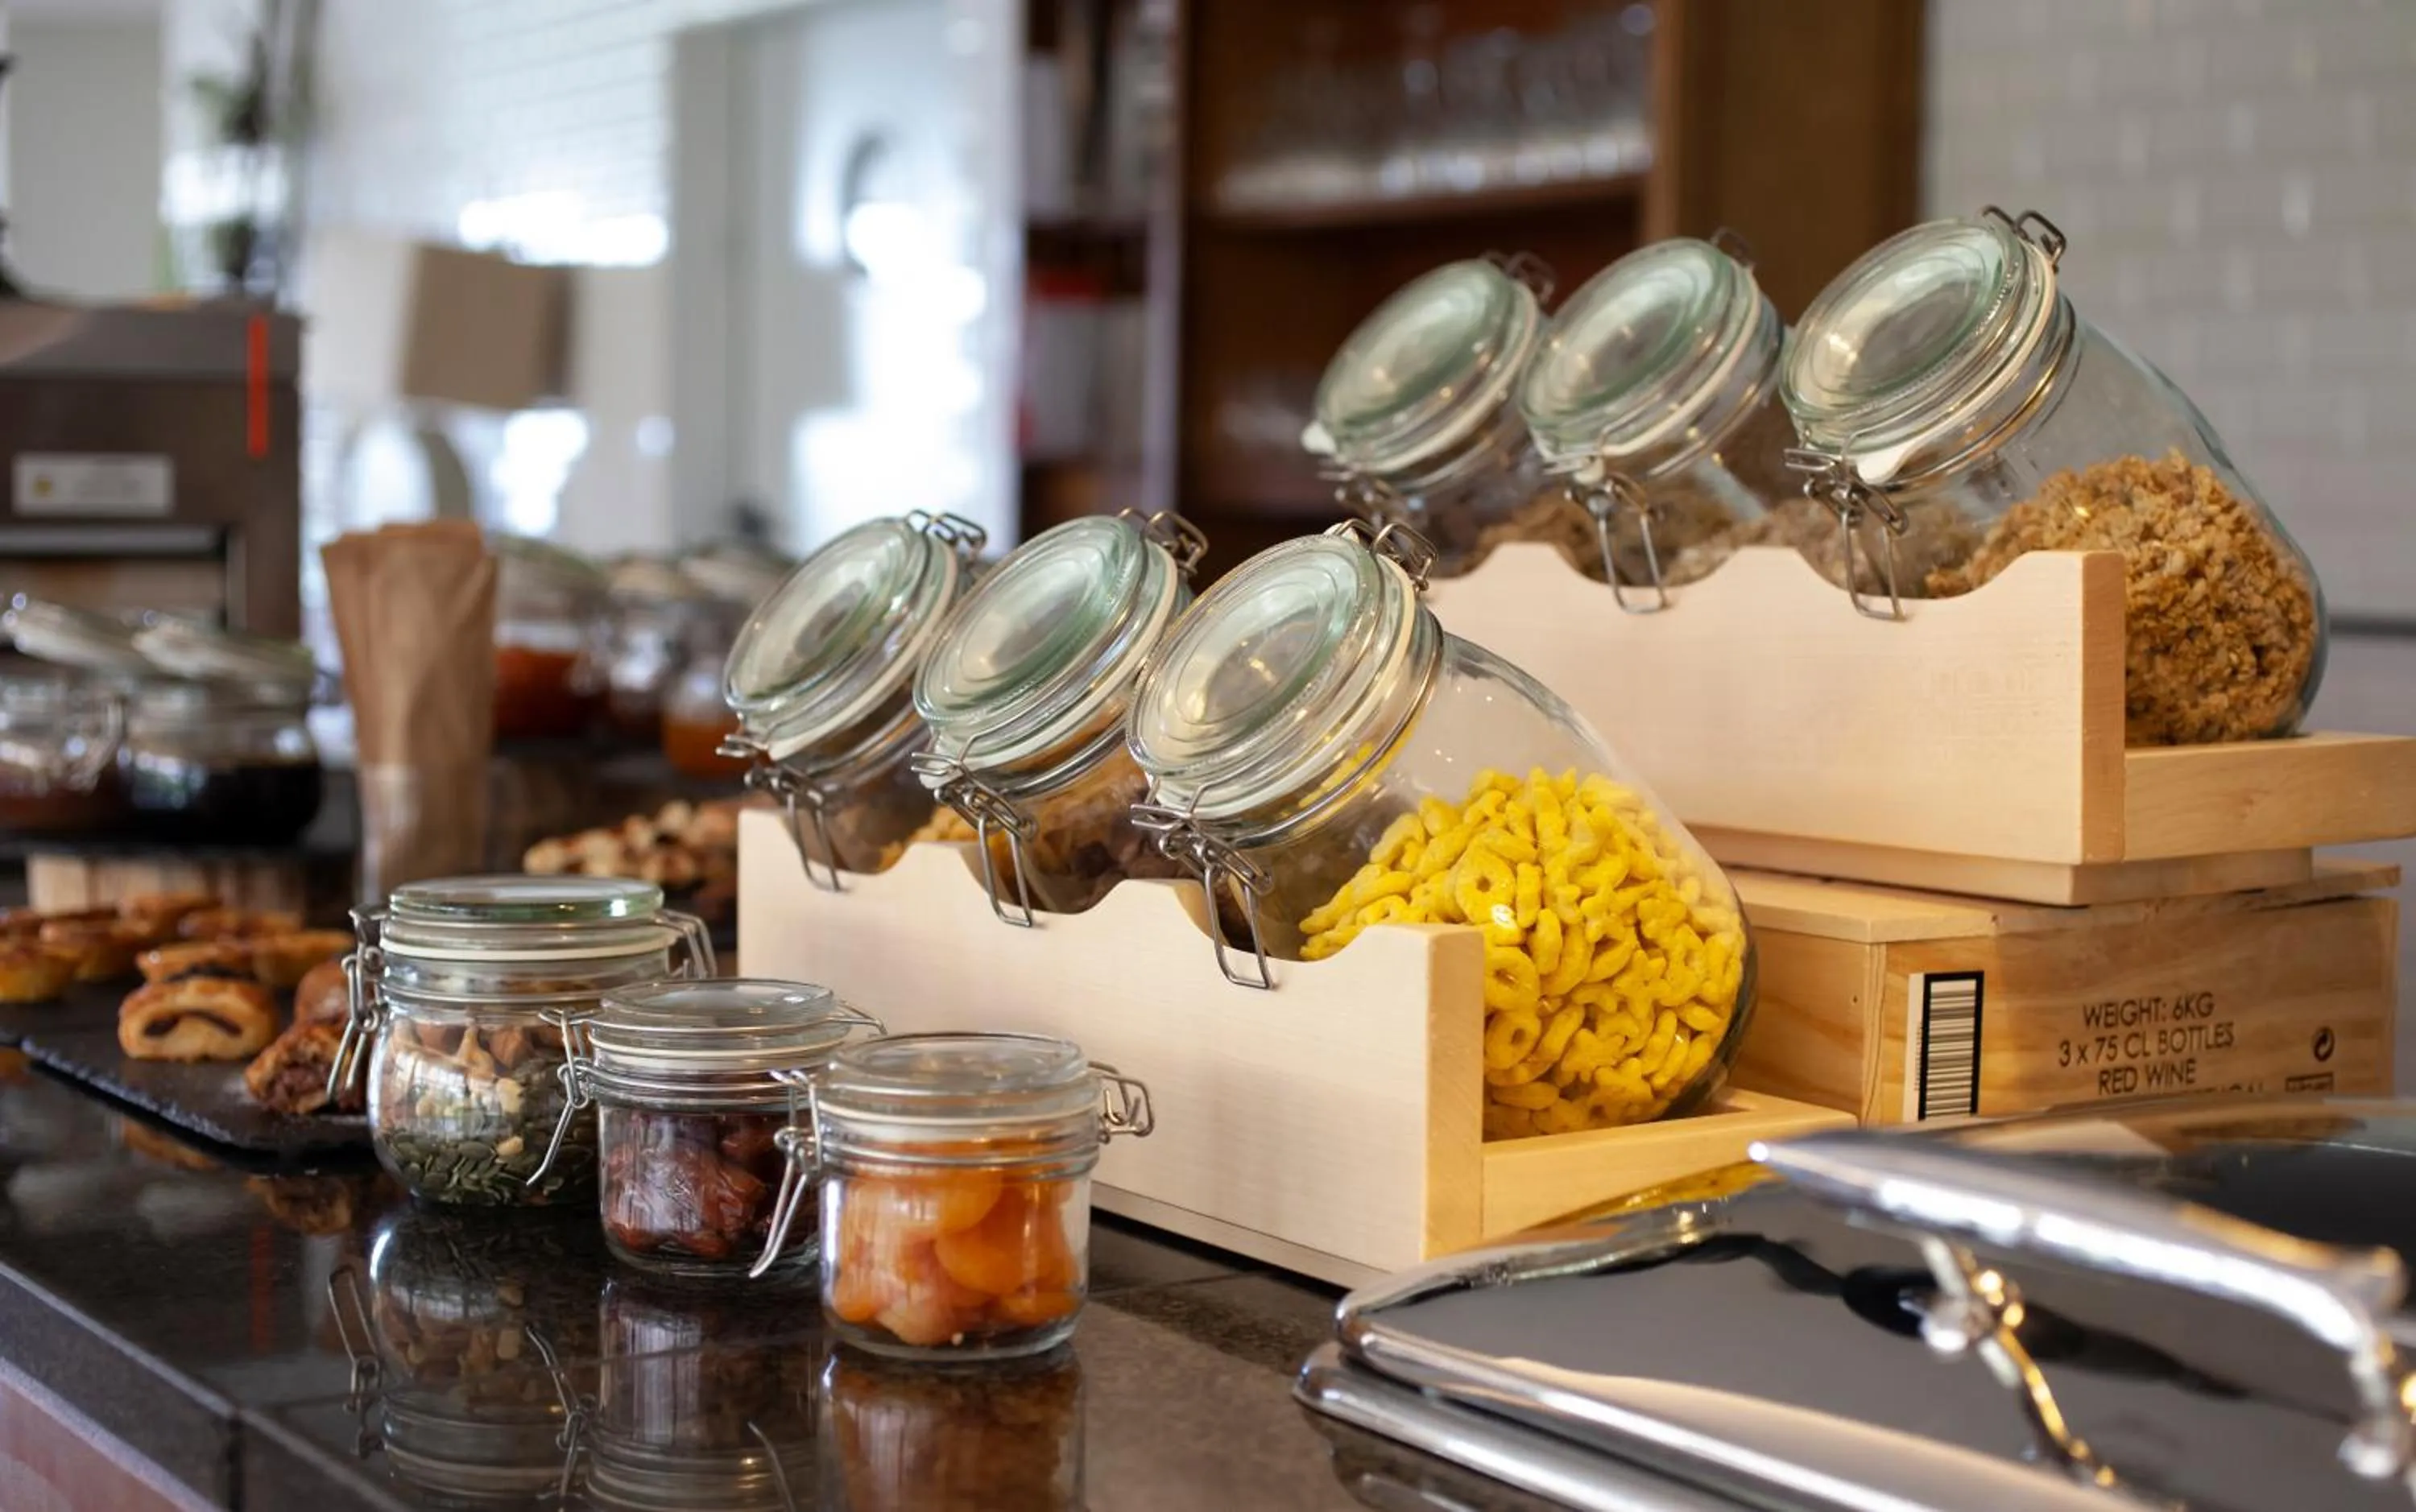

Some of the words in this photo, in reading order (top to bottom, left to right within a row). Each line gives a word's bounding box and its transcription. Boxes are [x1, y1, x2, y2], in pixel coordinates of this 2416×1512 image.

[2083, 996, 2167, 1028] WEIGHT:
[2173, 991, 2214, 1020] 6KG
[2058, 1039, 2071, 1067] 3
[2095, 1035, 2118, 1063] 75
[2124, 1031, 2151, 1059] CL
[2158, 1021, 2234, 1055] BOTTLES
[2098, 1067, 2138, 1095] RED
[2145, 1057, 2196, 1086] WINE
